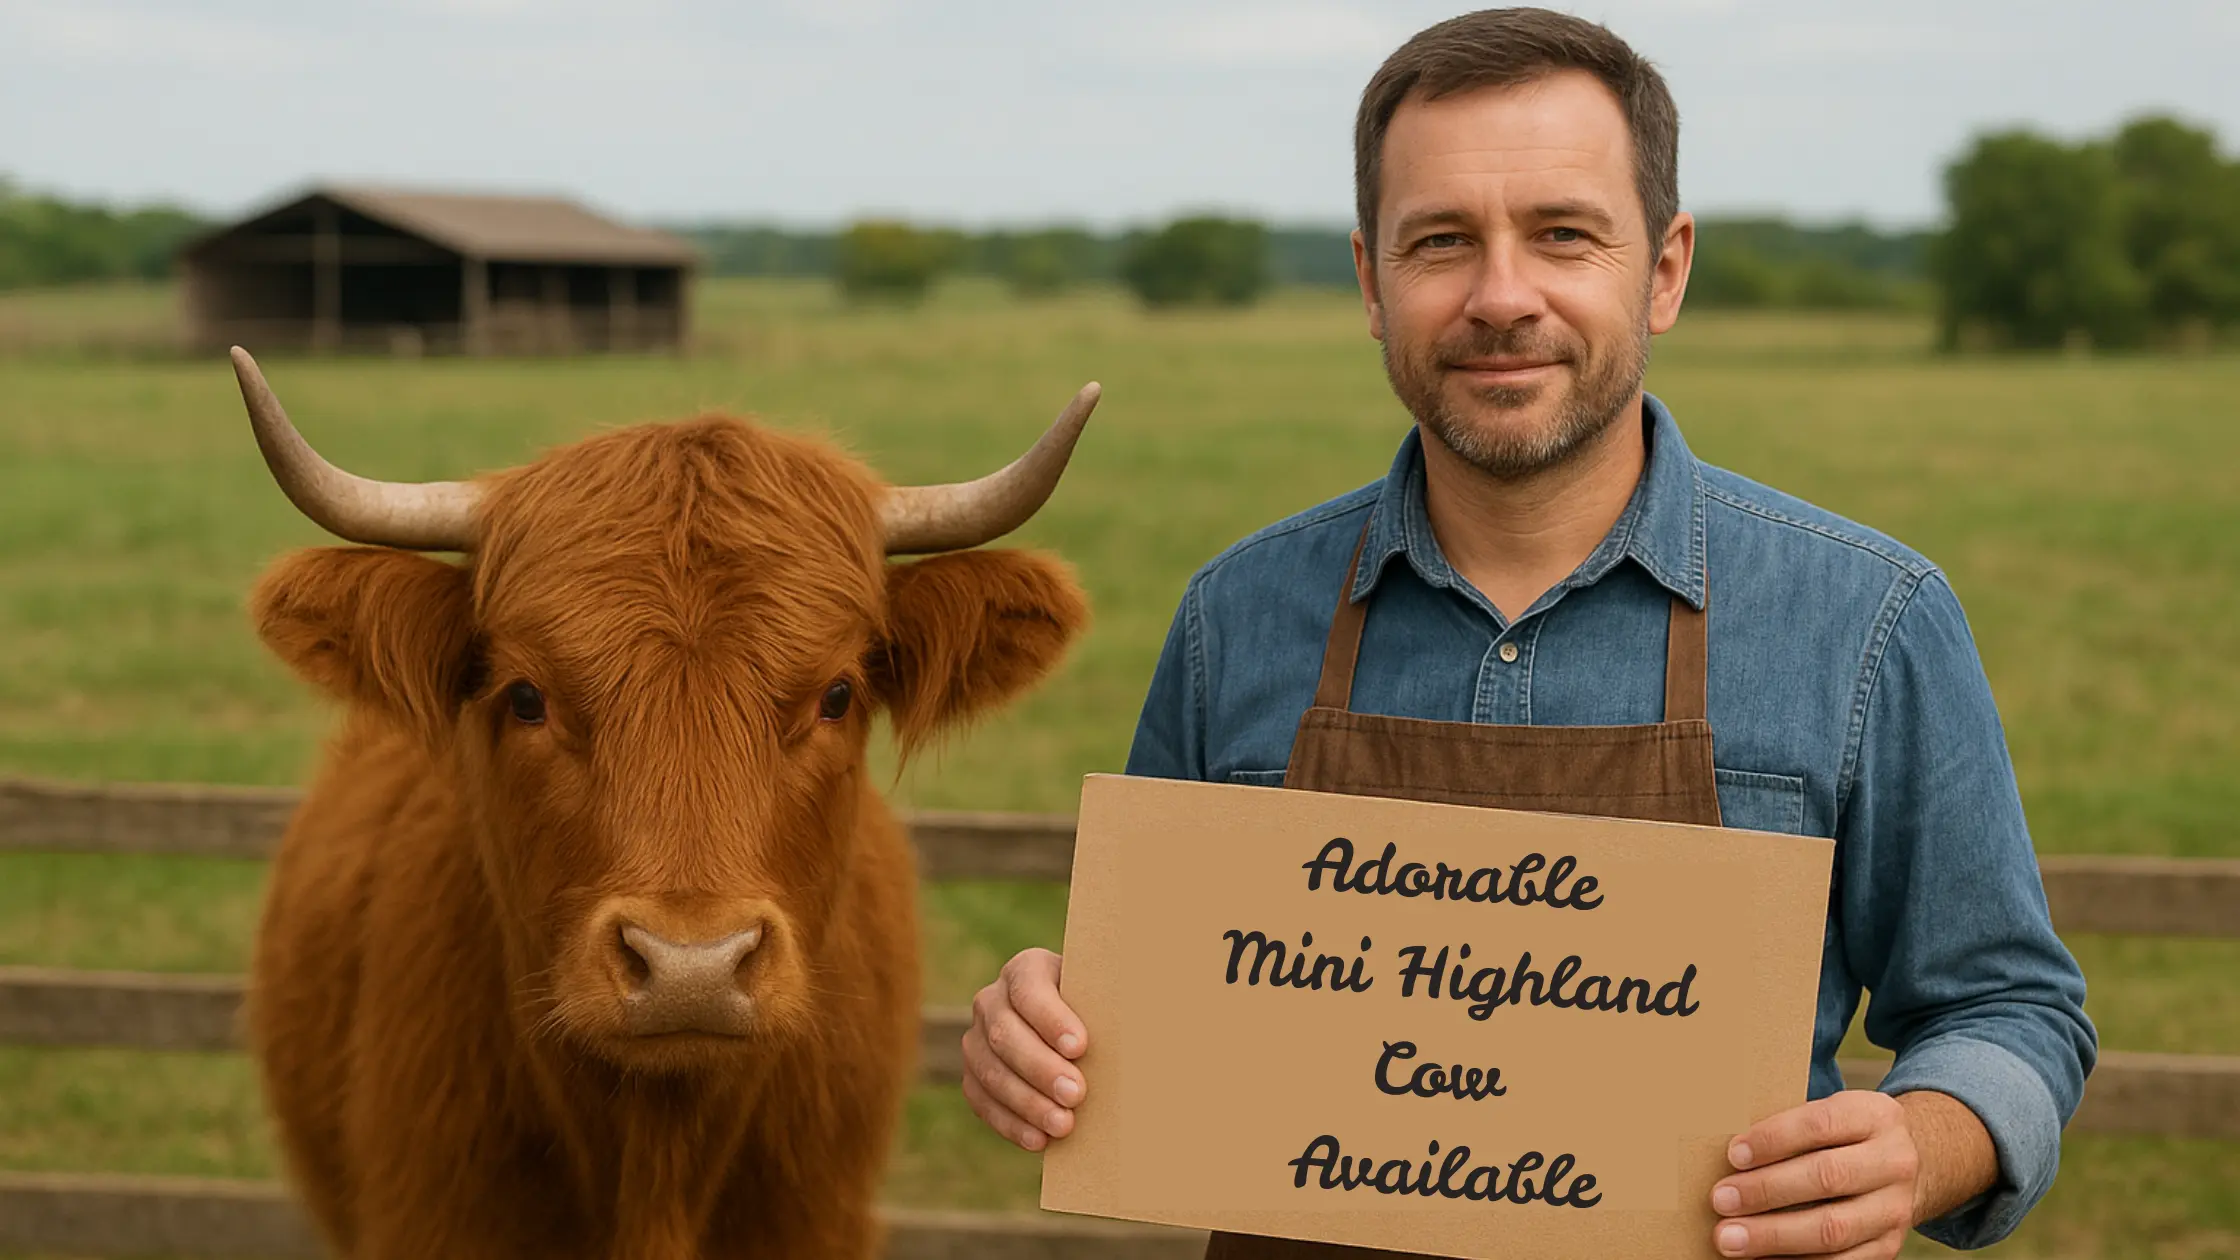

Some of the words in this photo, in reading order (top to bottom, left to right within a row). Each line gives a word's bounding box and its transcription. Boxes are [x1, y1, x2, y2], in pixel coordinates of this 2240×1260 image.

[1301, 837, 1605, 911] Adorable
[1222, 929, 1374, 993] Mini
[1398, 943, 1700, 1022] Highland
[1374, 1040, 1507, 1102] Cow
[1287, 1134, 1603, 1209] Available
